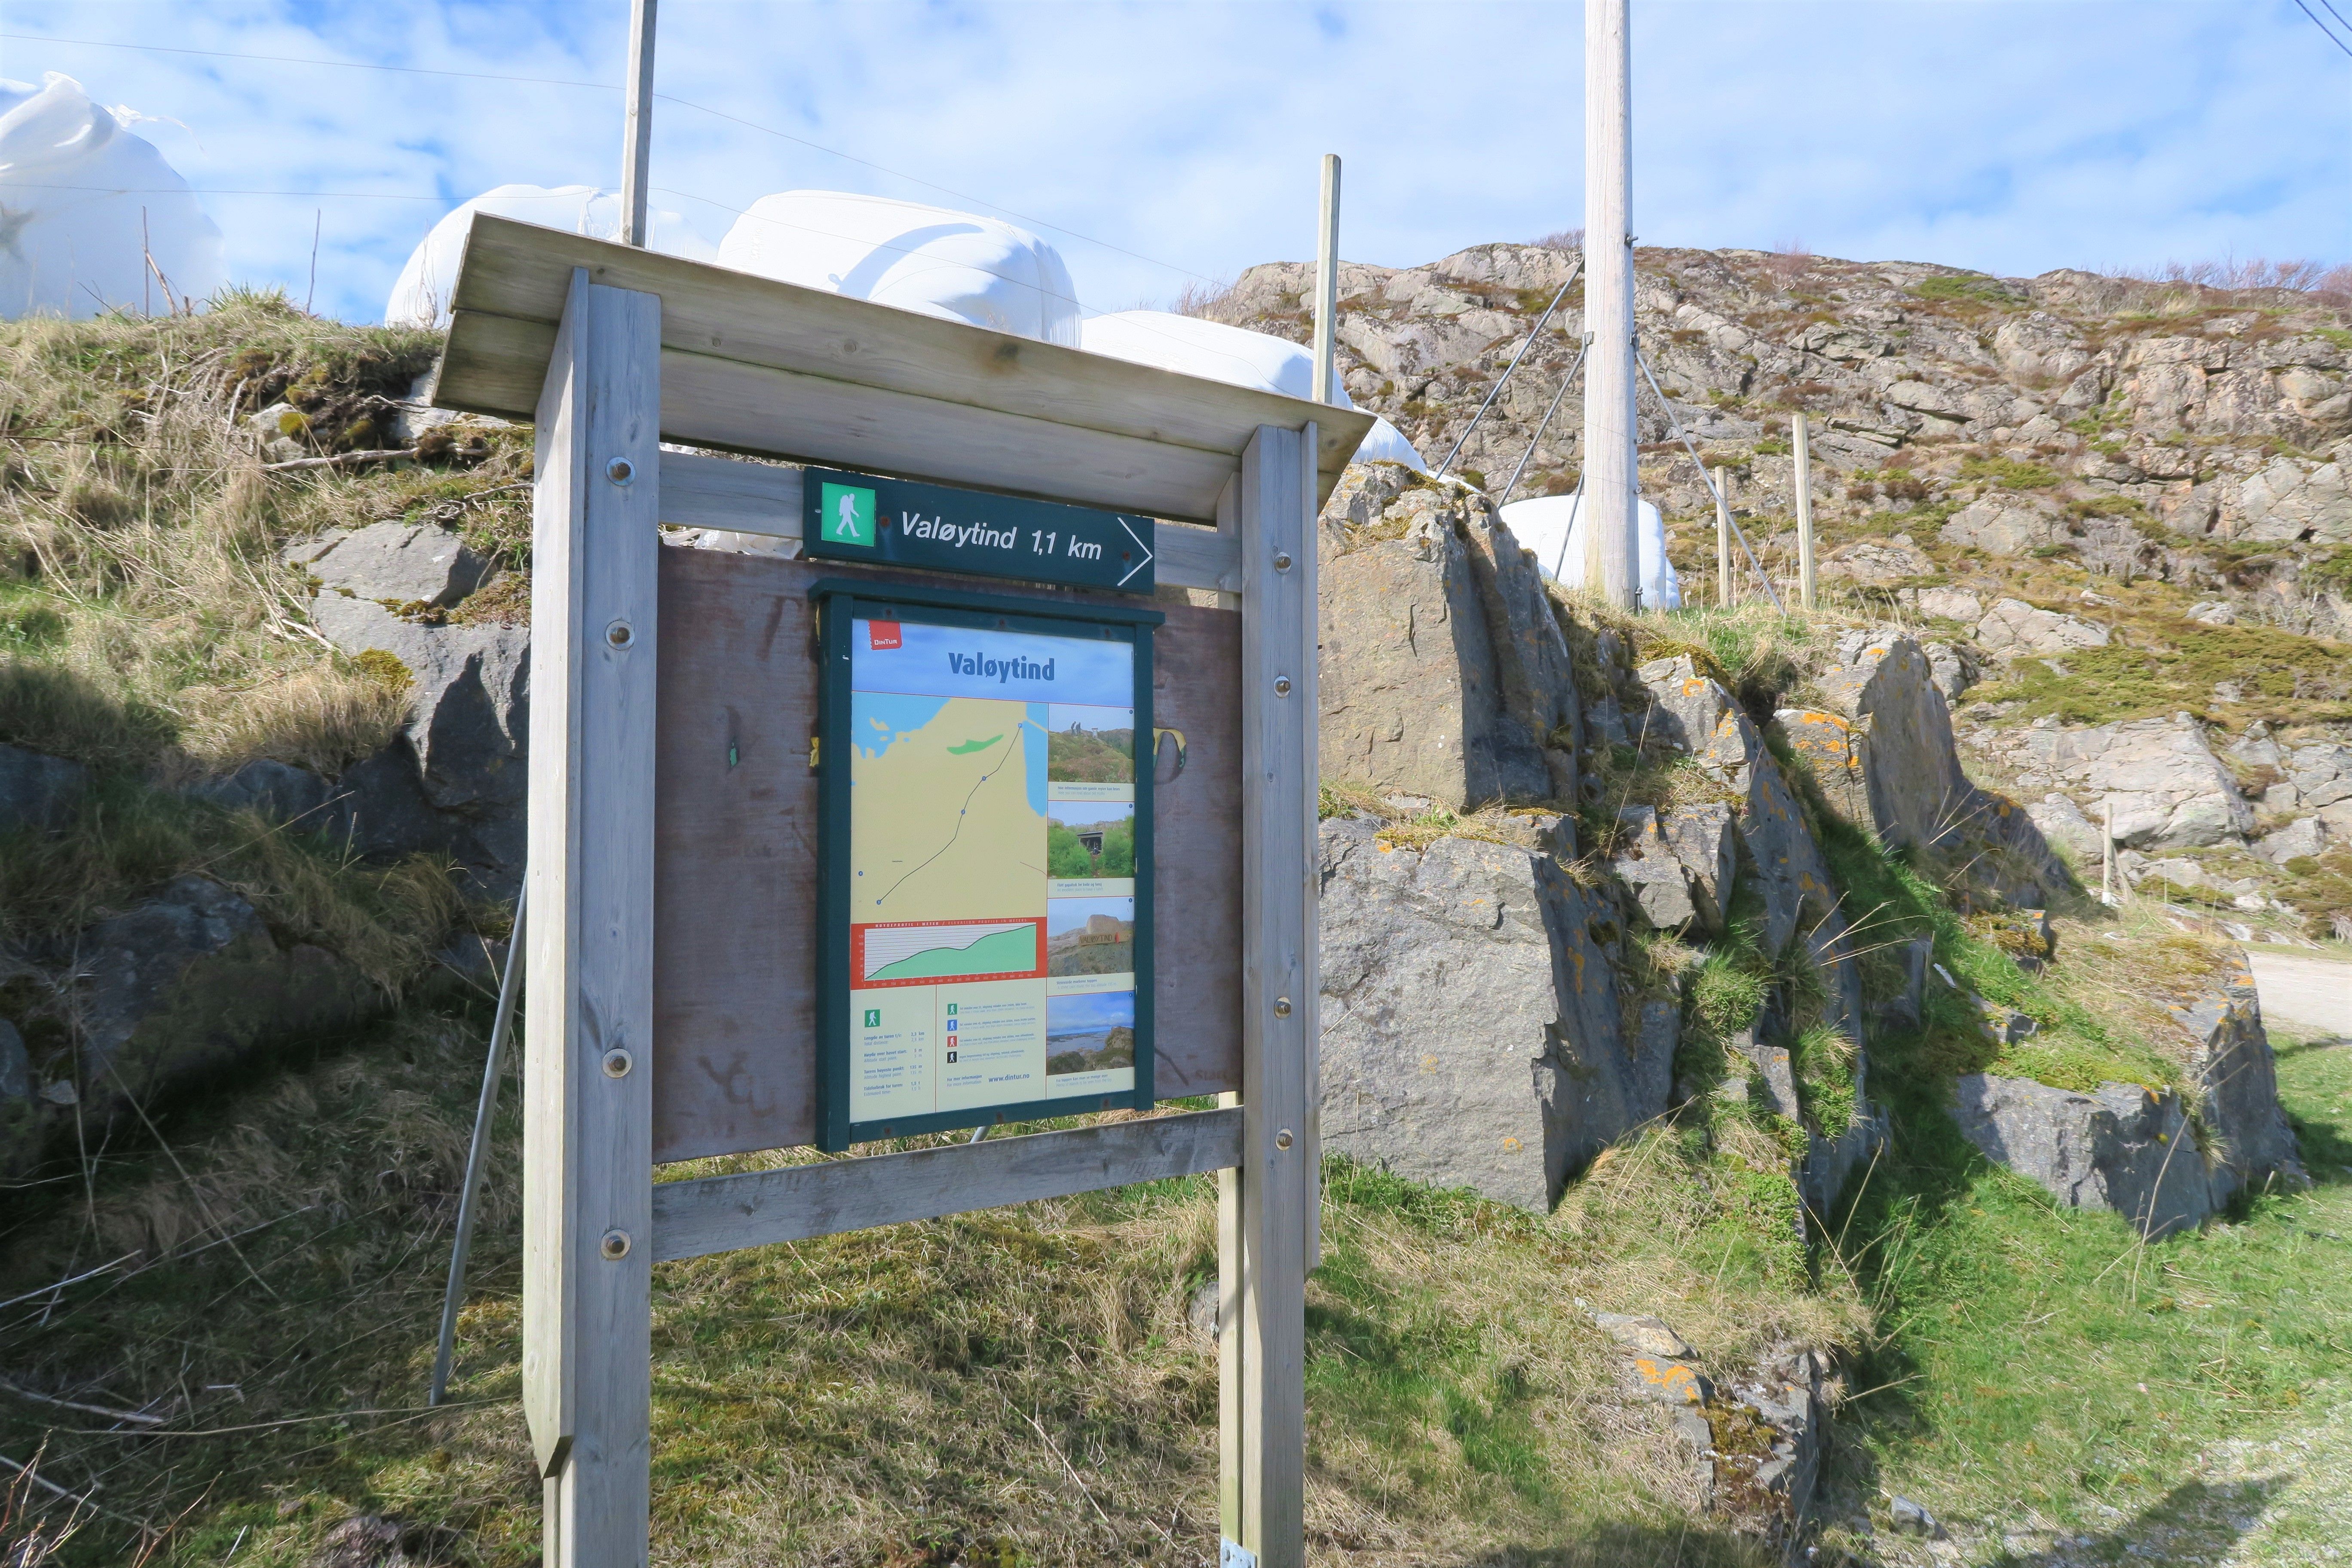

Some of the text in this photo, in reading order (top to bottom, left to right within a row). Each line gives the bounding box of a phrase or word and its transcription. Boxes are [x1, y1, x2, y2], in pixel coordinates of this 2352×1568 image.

[902, 511, 1102, 560] Valøytind 1,1 km
[948, 652, 1055, 684] Valøytind
[1080, 934, 1112, 943] VALØYTIND
[988, 1074, 1029, 1082] www.dintur.no
